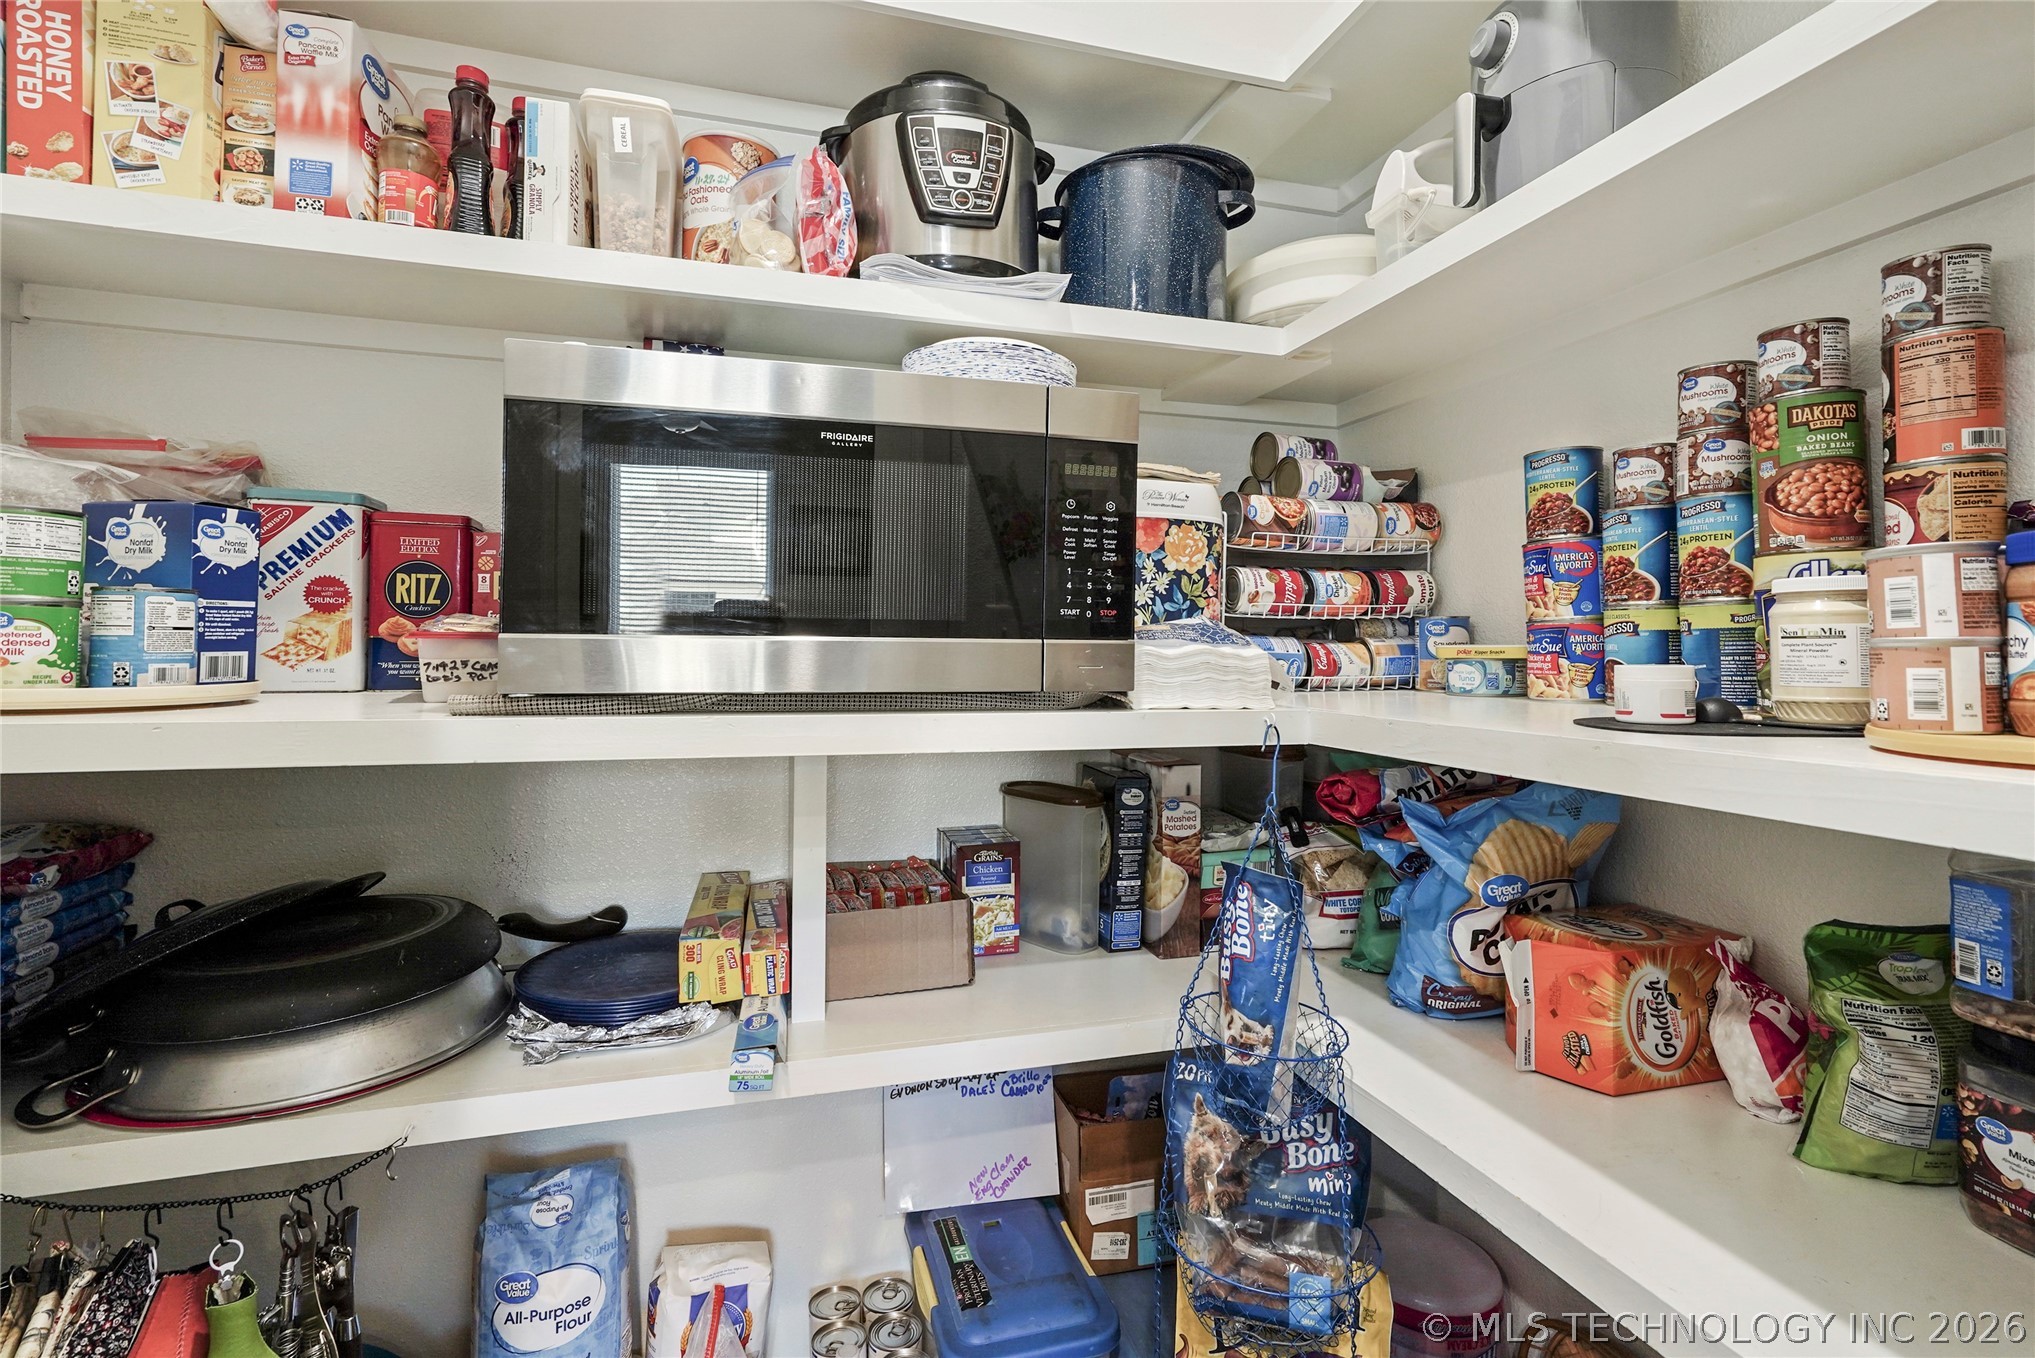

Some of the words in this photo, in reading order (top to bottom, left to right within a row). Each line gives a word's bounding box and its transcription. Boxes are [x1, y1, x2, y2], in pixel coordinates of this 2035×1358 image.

[45, 10, 72, 102] HONEY
[300, 48, 324, 56] Waffle
[325, 50, 338, 58] Mix
[951, 152, 970, 160] Power
[952, 158, 973, 166] Cooker
[689, 184, 732, 197] Fashioned
[690, 195, 709, 204] Oats
[1894, 280, 1915, 290] White
[1776, 346, 1796, 354] White
[1899, 338, 1943, 354] Nutrition
[1946, 334, 1976, 343] Facts
[1934, 356, 1951, 364] 230
[1681, 388, 1729, 402] Mushrooms
[1792, 404, 1857, 424] DAKOTA'S
[820, 431, 874, 442] FRIGIDAIRE
[1806, 432, 1848, 442] ONION
[1796, 444, 1827, 452] BAKED
[1830, 441, 1856, 449] BEANS
[1531, 453, 1566, 470] PROGRESSO
[1953, 470, 1999, 479] Nutrition
[1954, 498, 1993, 506] Calories
[1681, 500, 1721, 518] PROGRESSO
[1689, 524, 1709, 532] LENTIL
[130, 538, 154, 546] Nonfat
[224, 540, 248, 548] Nonfat
[400, 538, 440, 546] LIMITED
[1690, 533, 1732, 542] PROTEIN
[124, 546, 136, 556] Dry
[138, 546, 153, 554] Milk
[220, 546, 231, 554] Dry
[232, 546, 248, 555] Milk
[257, 508, 356, 592] PREMIUM
[400, 546, 440, 554] EDITION
[1606, 544, 1637, 552] PROTEIN
[1552, 552, 1594, 562] AMERICA'S
[264, 568, 304, 601] SALTINE
[305, 528, 356, 569] CRACKERS
[1555, 561, 1593, 571] FAVORITE
[1087, 568, 1092, 576] 2
[396, 573, 442, 604] RITZ
[1087, 582, 1092, 590] 5
[1426, 580, 1434, 604] SOUP
[404, 604, 432, 612] Crackers
[1086, 610, 1092, 618] 0
[1456, 648, 1472, 656] polar
[1166, 814, 1197, 823] Mashed
[1164, 823, 1197, 832] Potatoes
[974, 854, 1003, 862] GRAINS
[972, 866, 1004, 874] Chicken
[1486, 882, 1522, 898] Great
[1496, 893, 1521, 903] Value
[1232, 884, 1250, 958] Bone
[1260, 898, 1278, 942] tiny
[1221, 901, 1237, 981] Busy
[685, 944, 696, 963] 300
[726, 948, 738, 969] GLAD
[716, 955, 726, 974] CLING
[767, 956, 776, 978] PLASTIC
[718, 974, 728, 995] WRAP
[768, 979, 777, 994] WRAP
[1427, 982, 1475, 1002] Crispy
[1426, 998, 1482, 1010] ORIGINAL
[1844, 1000, 1897, 1015] Nutrition
[1899, 1006, 1923, 1016] Facts
[1644, 977, 1678, 1060] Goldfish
[1670, 1010, 1680, 1040] BAKED
[1566, 1032, 1580, 1069] BLASTED
[1008, 1070, 1040, 1086] Brillo
[1176, 1062, 1196, 1082] 20
[736, 1082, 750, 1090] 75
[1980, 1118, 2006, 1138] Great
[1287, 1142, 1354, 1169] Bone
[1308, 1173, 1352, 1196] mini
[536, 1200, 552, 1208] Flour
[1254, 1198, 1272, 1209] Meaty
[1274, 1200, 1294, 1211] Middle
[1296, 1204, 1312, 1212] Made
[1312, 1205, 1327, 1214] With
[1278, 1192, 1315, 1206] Long-Lasting
[1316, 1197, 1332, 1207] Chew
[535, 1202, 570, 1214] All-Purpose
[956, 1246, 970, 1261] EN
[499, 1279, 532, 1293] Great
[965, 1263, 984, 1309] VETERINARY
[978, 1272, 990, 1293] DIETS
[506, 1288, 531, 1298] Value
[504, 1296, 592, 1325] All-Purpose
[555, 1310, 592, 1334] Flour
